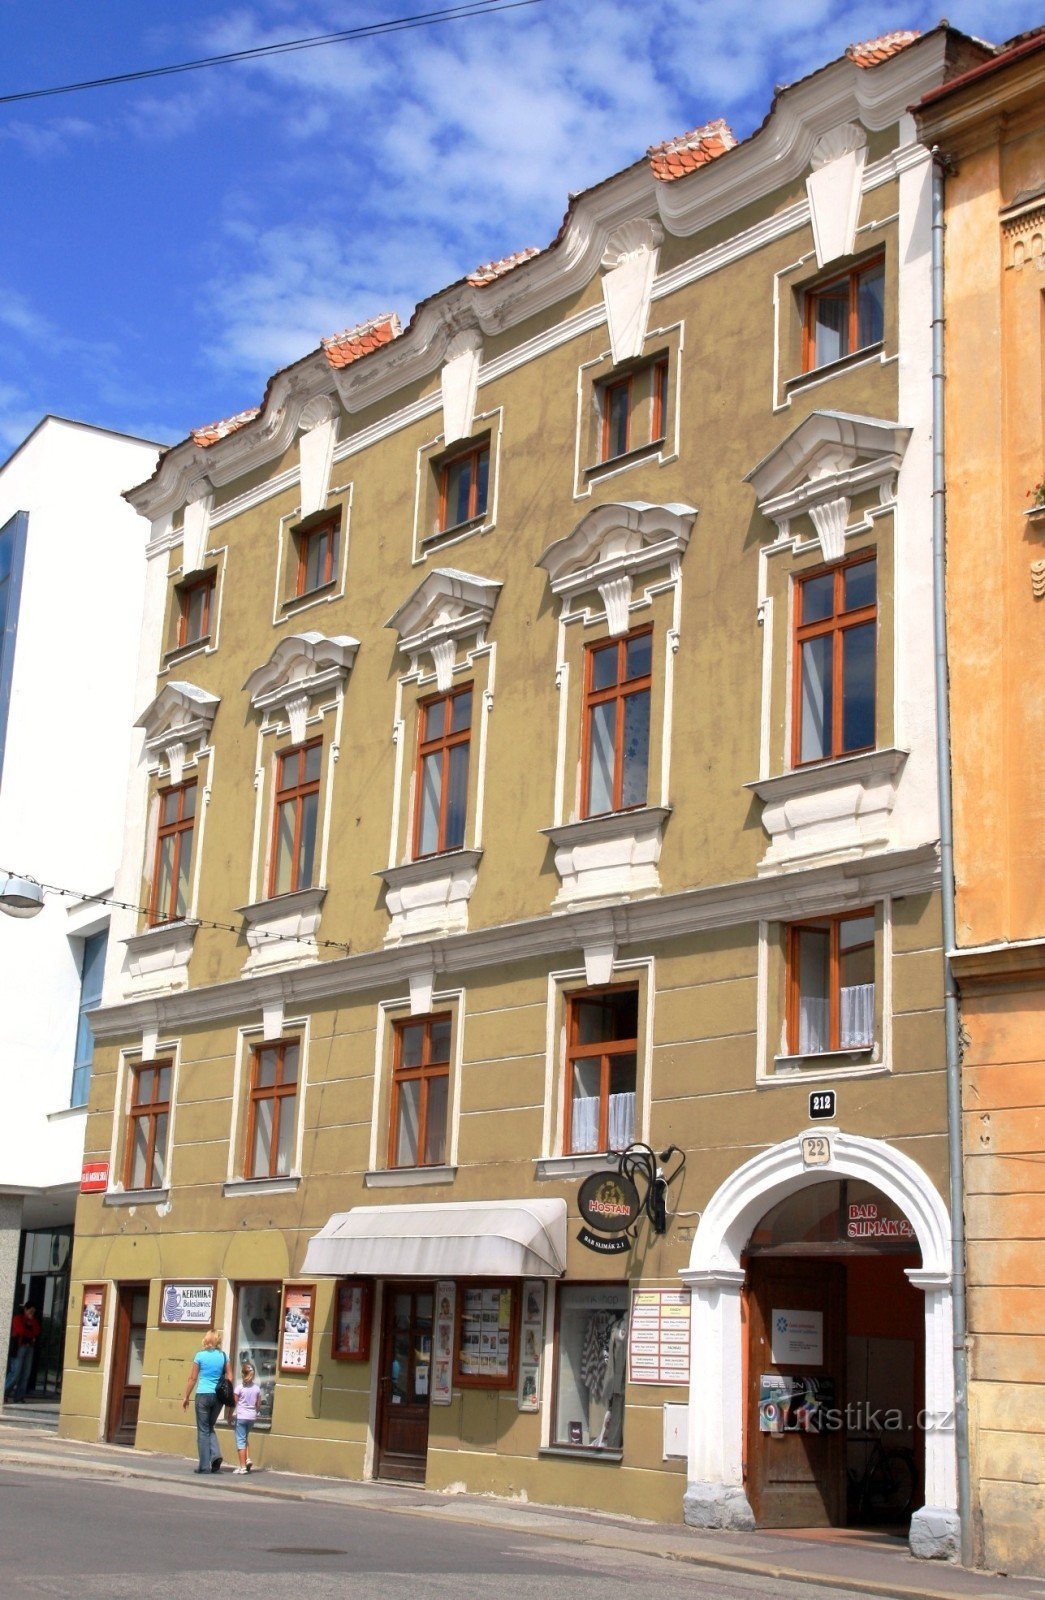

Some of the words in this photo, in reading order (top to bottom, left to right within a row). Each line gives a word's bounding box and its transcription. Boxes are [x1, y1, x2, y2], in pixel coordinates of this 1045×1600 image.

[813, 1096, 831, 1109] 212
[807, 1140, 825, 1157] 22
[588, 1199, 631, 1216] HOSTAN
[849, 1204, 878, 1219] BAR
[583, 1235, 595, 1246] BAR
[182, 1289, 211, 1299] KERAMIKA
